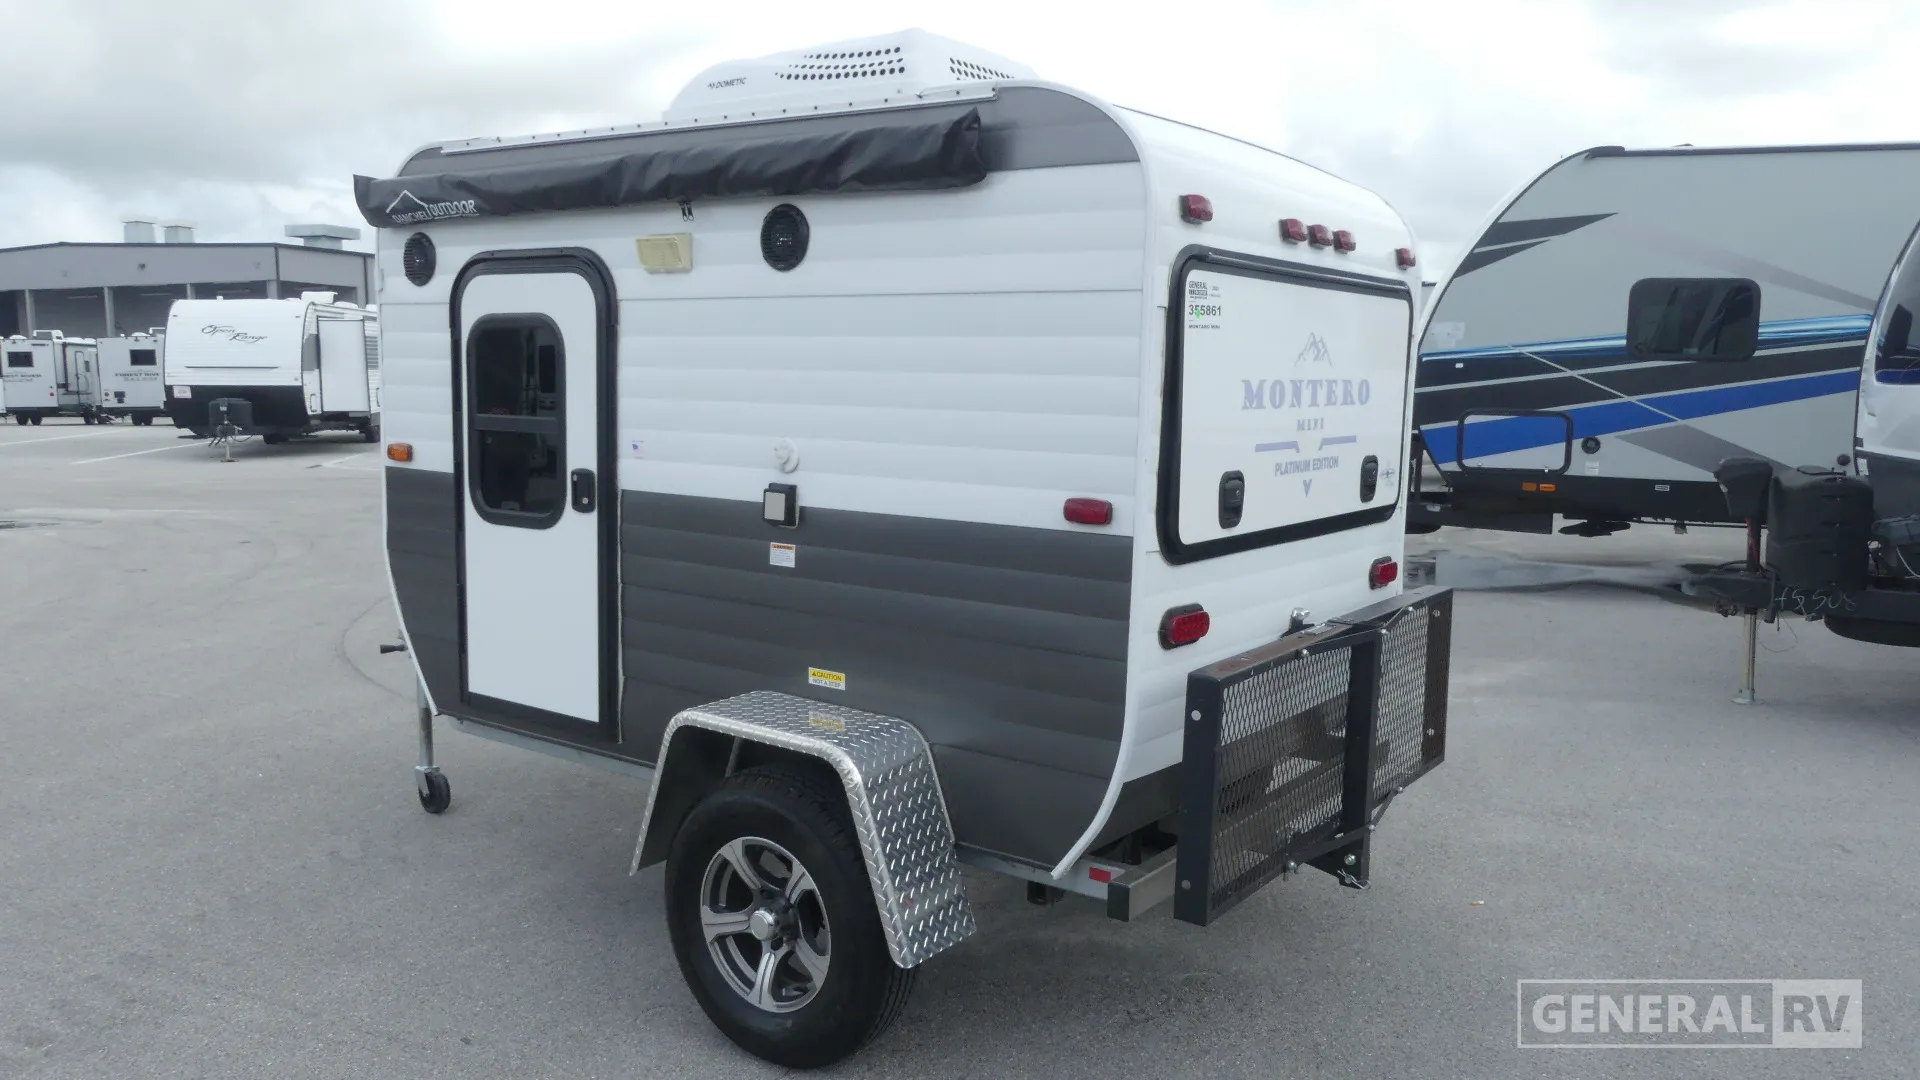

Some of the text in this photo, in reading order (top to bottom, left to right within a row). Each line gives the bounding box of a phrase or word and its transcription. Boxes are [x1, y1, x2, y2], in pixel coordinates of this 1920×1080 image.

[429, 199, 478, 217] OUTDOOR
[1188, 304, 1222, 317] 355861
[201, 324, 236, 337] Open
[229, 332, 269, 344] Range
[1241, 378, 1371, 410] MONTERO
[1296, 418, 1324, 431] MINI
[1274, 456, 1339, 477] PLATINUM EDITION
[816, 671, 842, 682] CAUTION
